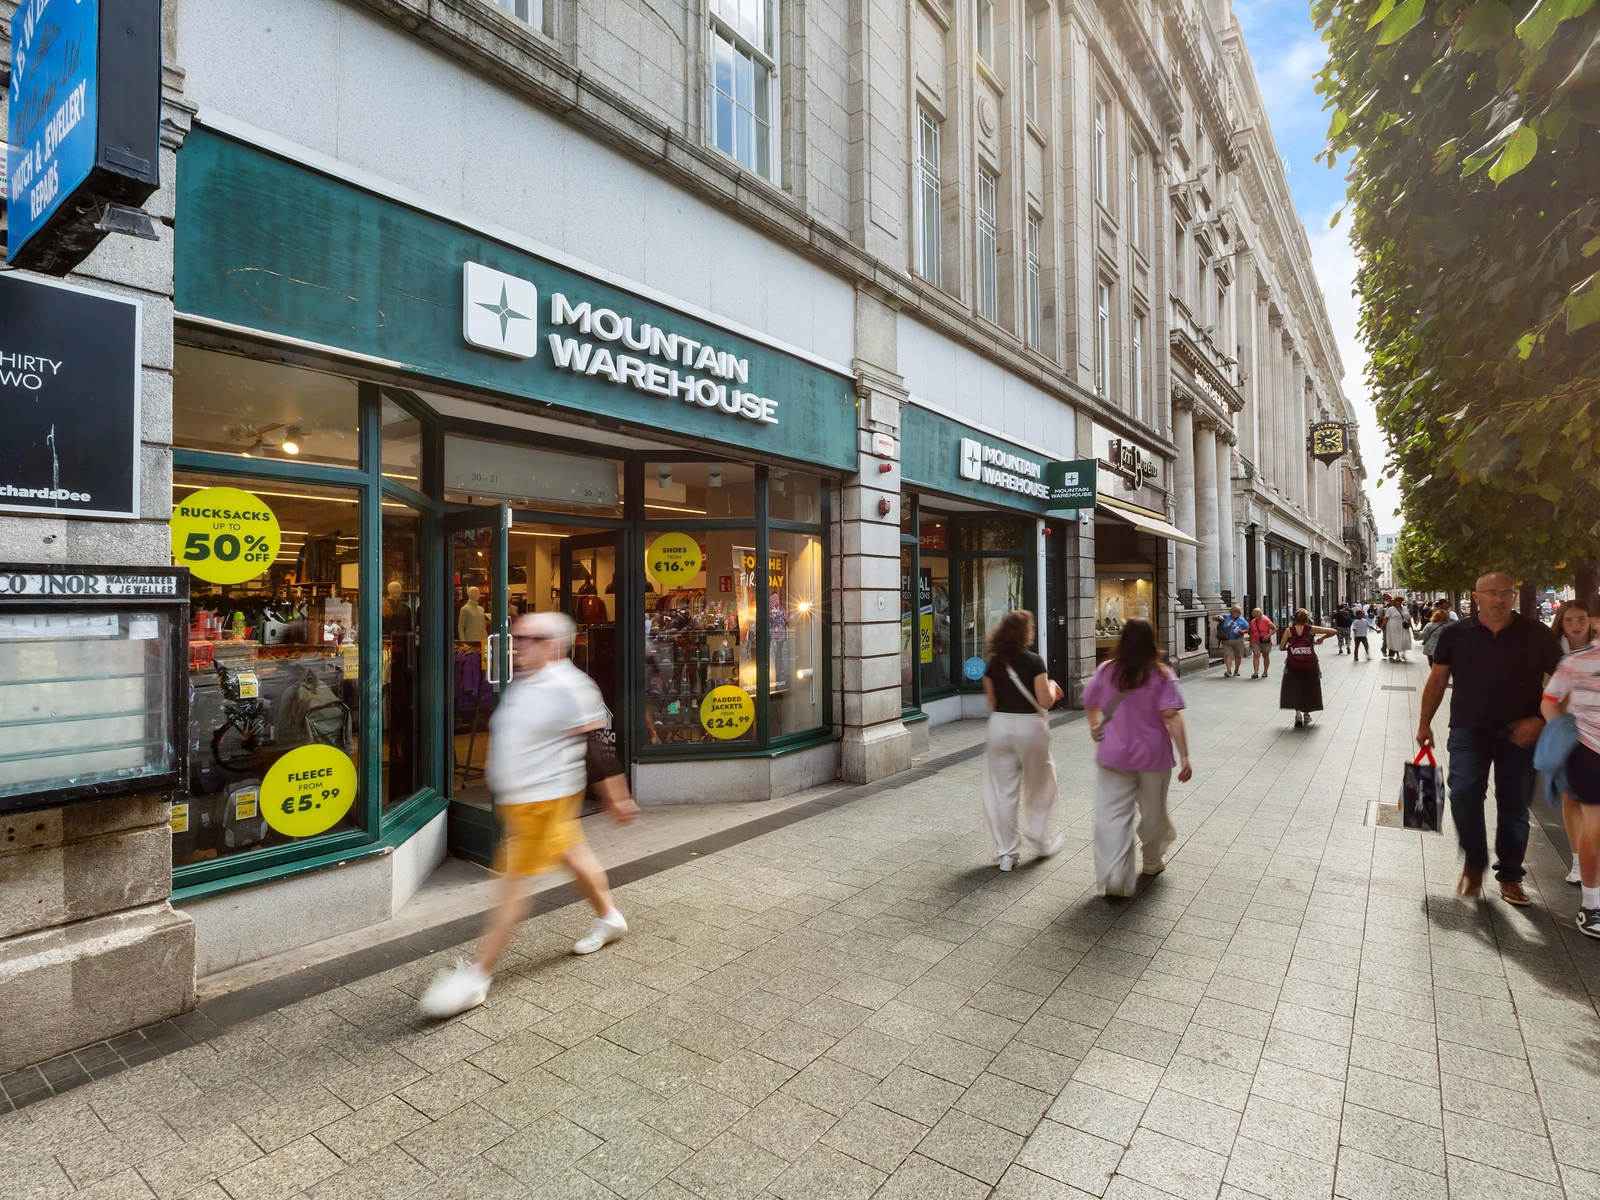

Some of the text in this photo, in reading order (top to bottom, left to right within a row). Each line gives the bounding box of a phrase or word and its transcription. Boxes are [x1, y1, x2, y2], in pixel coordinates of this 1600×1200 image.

[11, 78, 87, 204] WATCH & JEWELLERY
[30, 159, 59, 222] REPAIRS
[551, 292, 748, 384] MOUNTAIN
[548, 333, 779, 425] WAREHOUSE
[982, 445, 1041, 478] MOUNTAIN
[471, 473, 482, 481] 30
[489, 475, 498, 483] 31
[982, 466, 1050, 500] WAREHOUSE
[583, 489, 593, 497] 30
[1051, 491, 1093, 499] WAREHOUSE
[180, 507, 271, 522] RUCKSACKS
[212, 522, 241, 531] UP TO
[183, 532, 270, 562] 50%
[244, 553, 270, 562] OFF
[741, 555, 782, 571] FO HE
[654, 560, 696, 573] €16.99
[105, 575, 174, 585] WATCHMAKER
[740, 571, 756, 588] FIR
[901, 575, 931, 591] FIAL
[105, 584, 174, 594] & JEWELLER
[1290, 646, 1312, 655] VANS
[966, 666, 984, 675] 15%
[712, 696, 742, 704] PADDED
[711, 703, 743, 712] JACKETS
[706, 716, 750, 729] €24.99
[288, 767, 333, 783] FLEECE
[298, 782, 323, 792] FROM
[280, 788, 340, 815] €5.99
